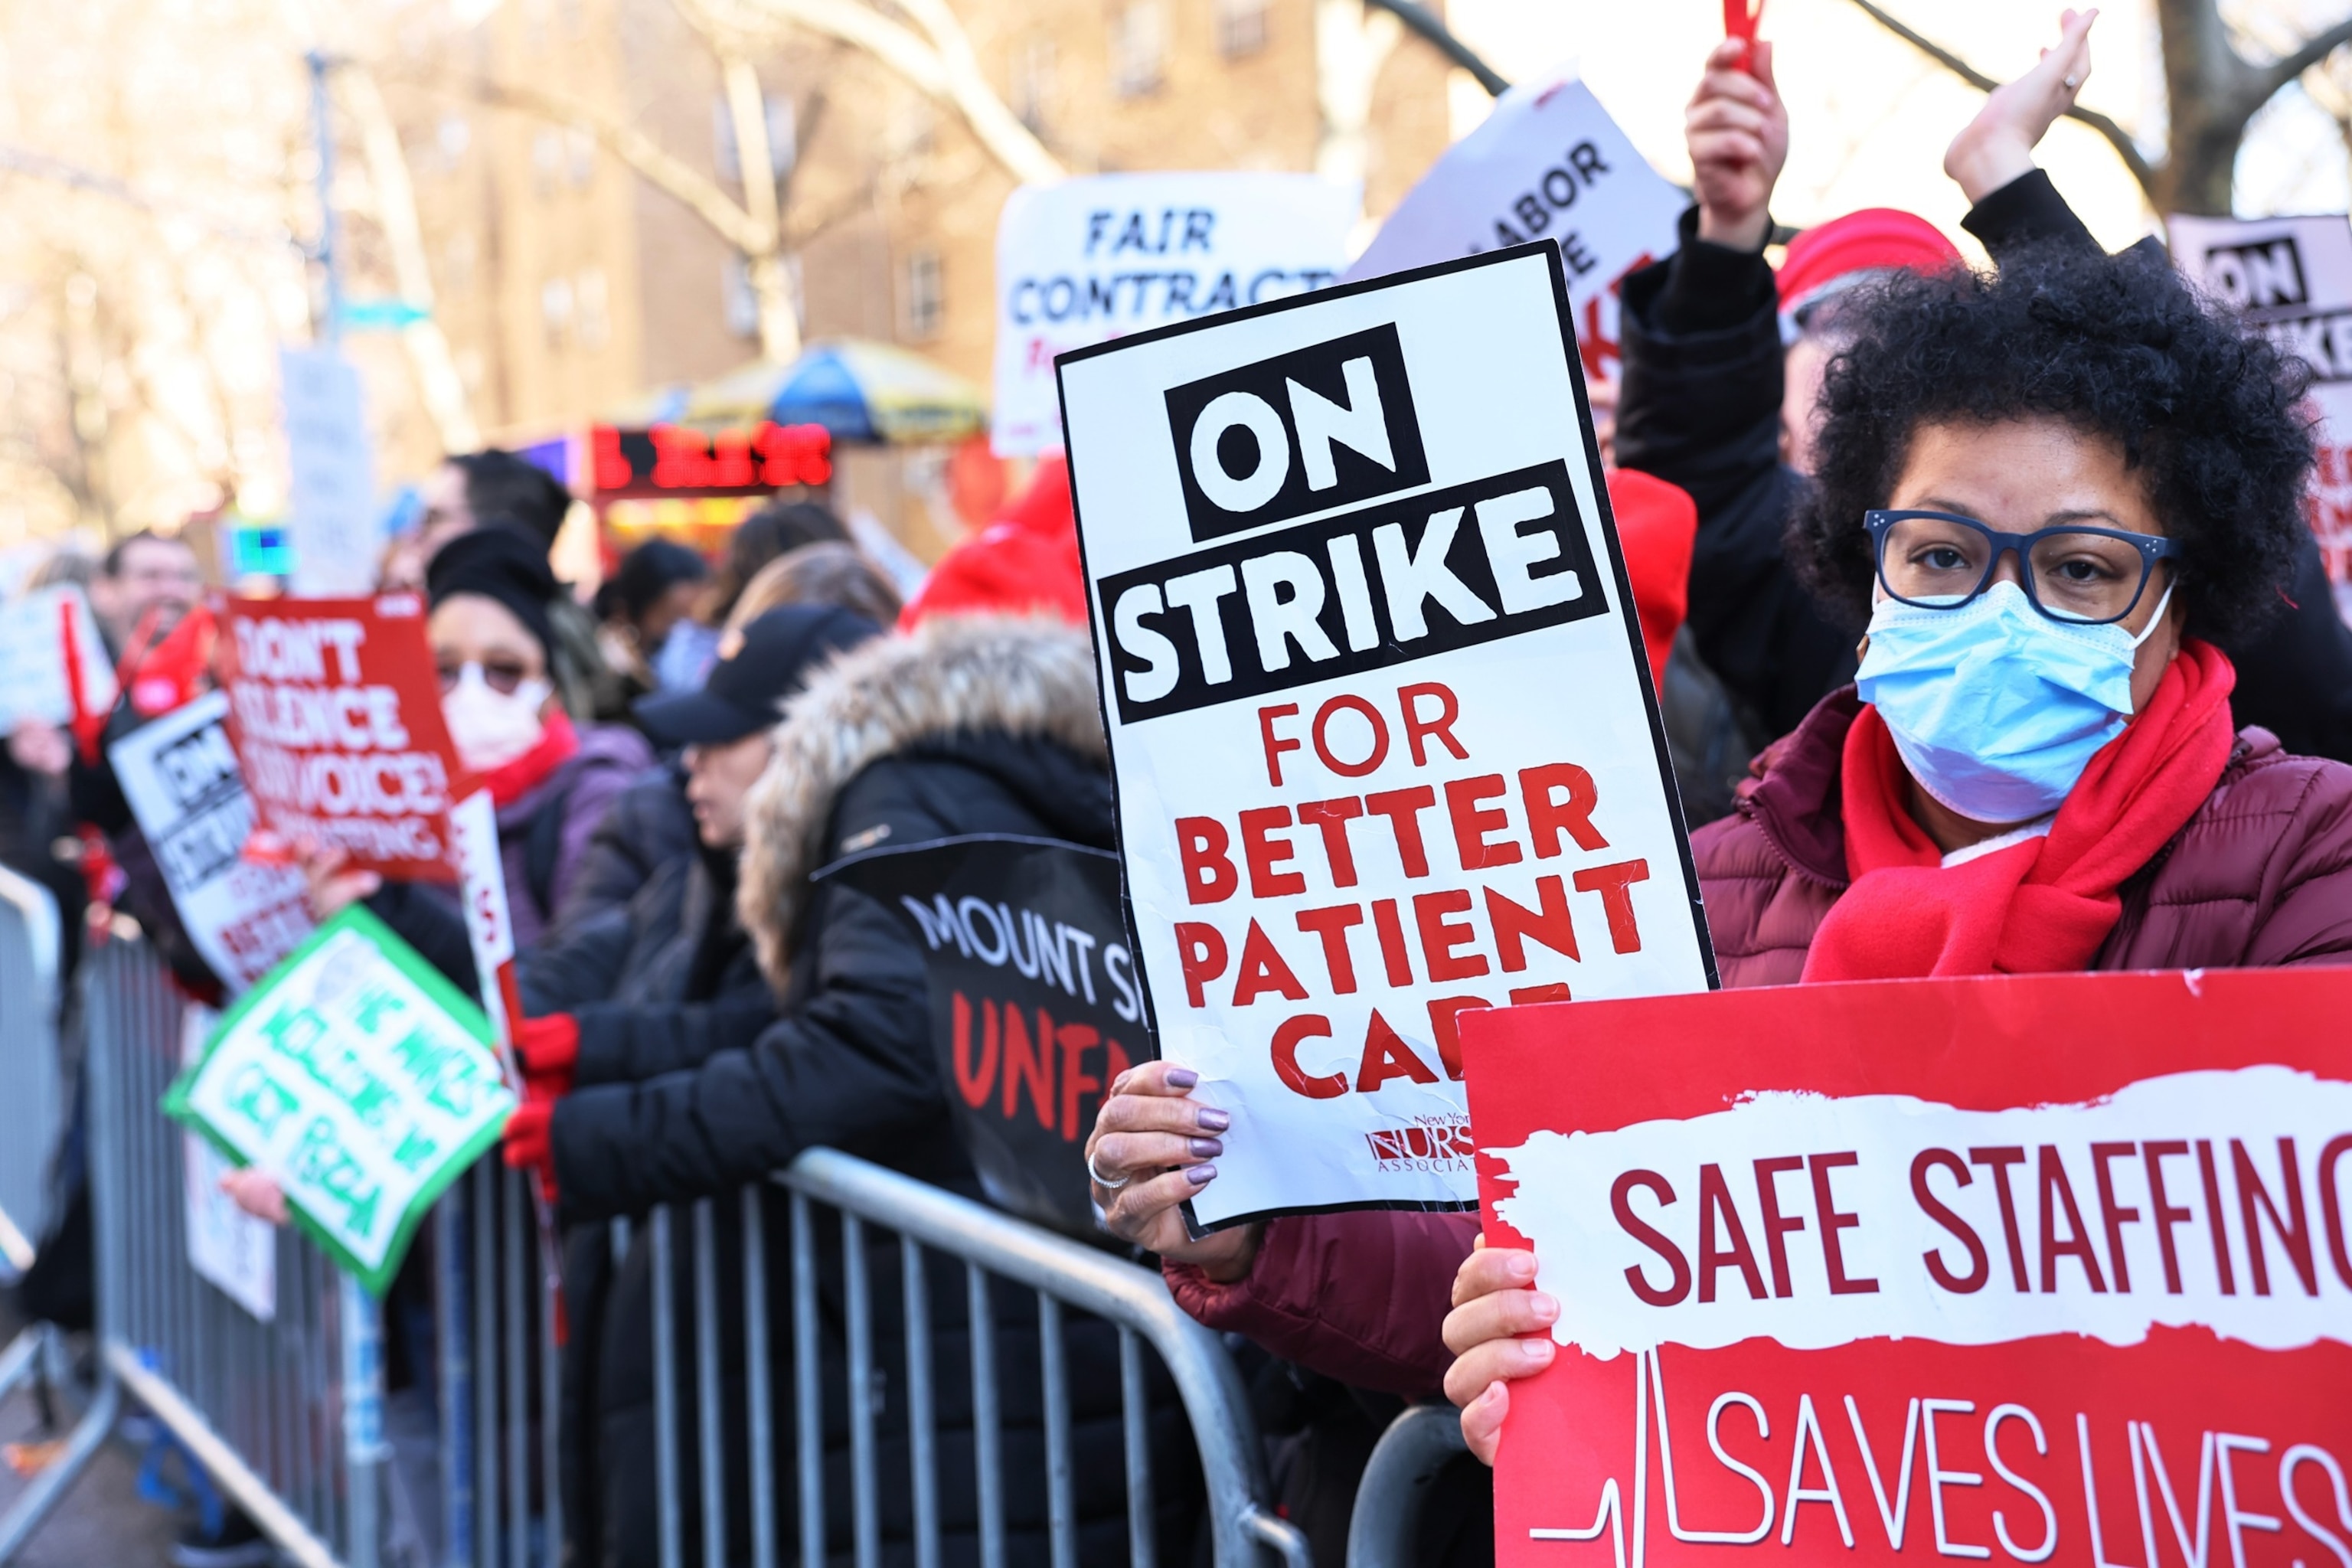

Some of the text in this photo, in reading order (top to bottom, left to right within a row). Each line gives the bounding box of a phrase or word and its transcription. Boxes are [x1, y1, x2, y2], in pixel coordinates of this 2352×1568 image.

[1084, 208, 1216, 256] FAIR
[1472, 139, 1611, 253] ABOR
[2208, 243, 2305, 308] ON
[1189, 354, 1396, 512] ON
[1113, 485, 1583, 703] STRIKE
[1257, 681, 1469, 787] FOR
[1174, 762, 1611, 906] BETTER
[900, 892, 1096, 1006] MOUNT
[1173, 858, 1650, 1008] PATIENT
[1364, 1125, 1475, 1160] NURS
[1378, 1158, 1475, 1172] ASSOCIA
[1414, 1112, 1470, 1127] New Yor
[1610, 1150, 1881, 1308] SAFE
[1704, 1391, 2352, 1568] SAVES LIVES
